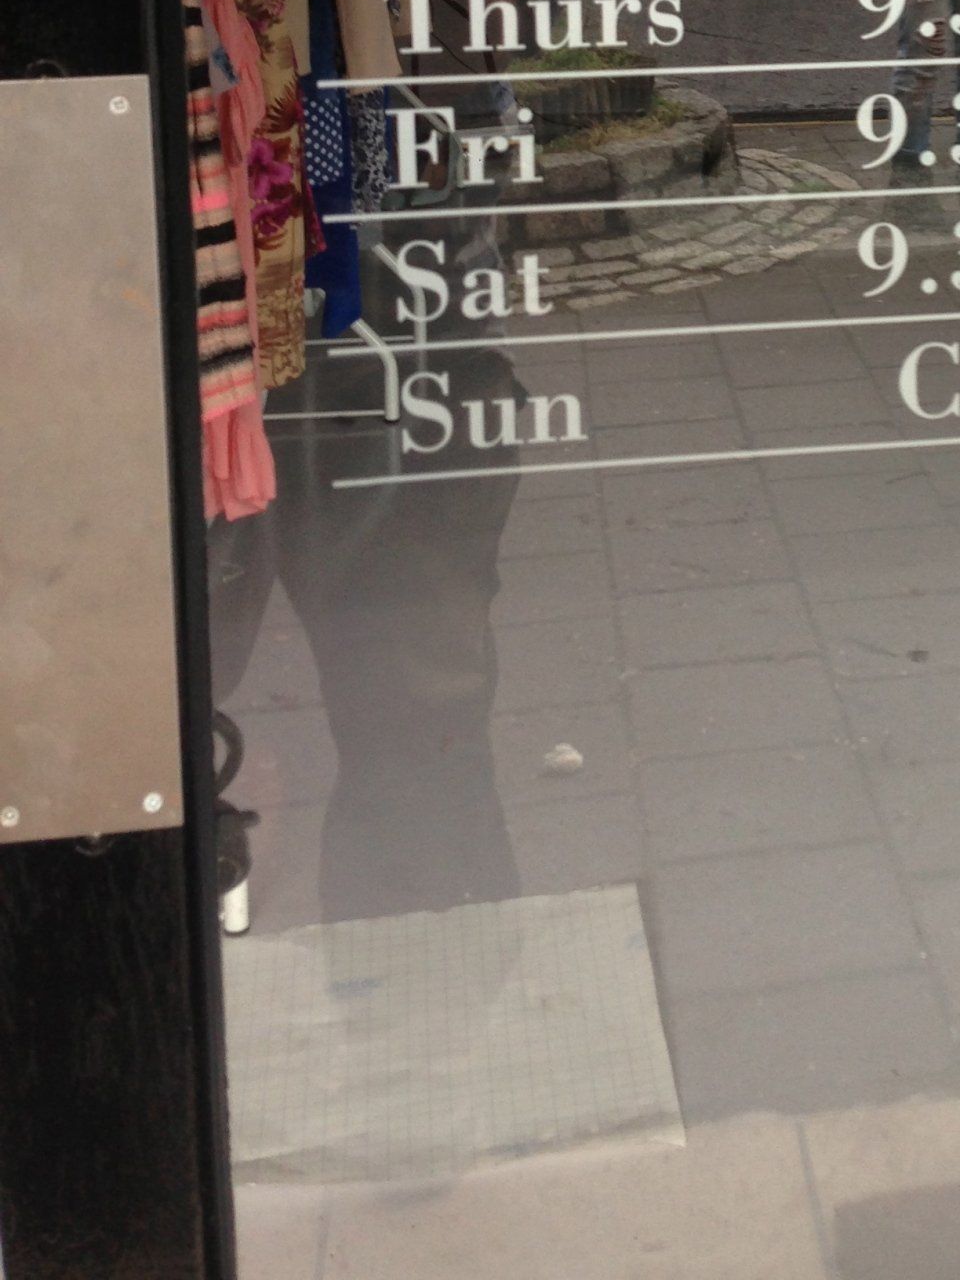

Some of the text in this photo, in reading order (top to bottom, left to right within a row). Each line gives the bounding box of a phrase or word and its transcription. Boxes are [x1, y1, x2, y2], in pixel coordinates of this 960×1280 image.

[387, 107, 544, 190] Fri
[396, 240, 554, 322] Sat
[401, 372, 588, 453] Sun
